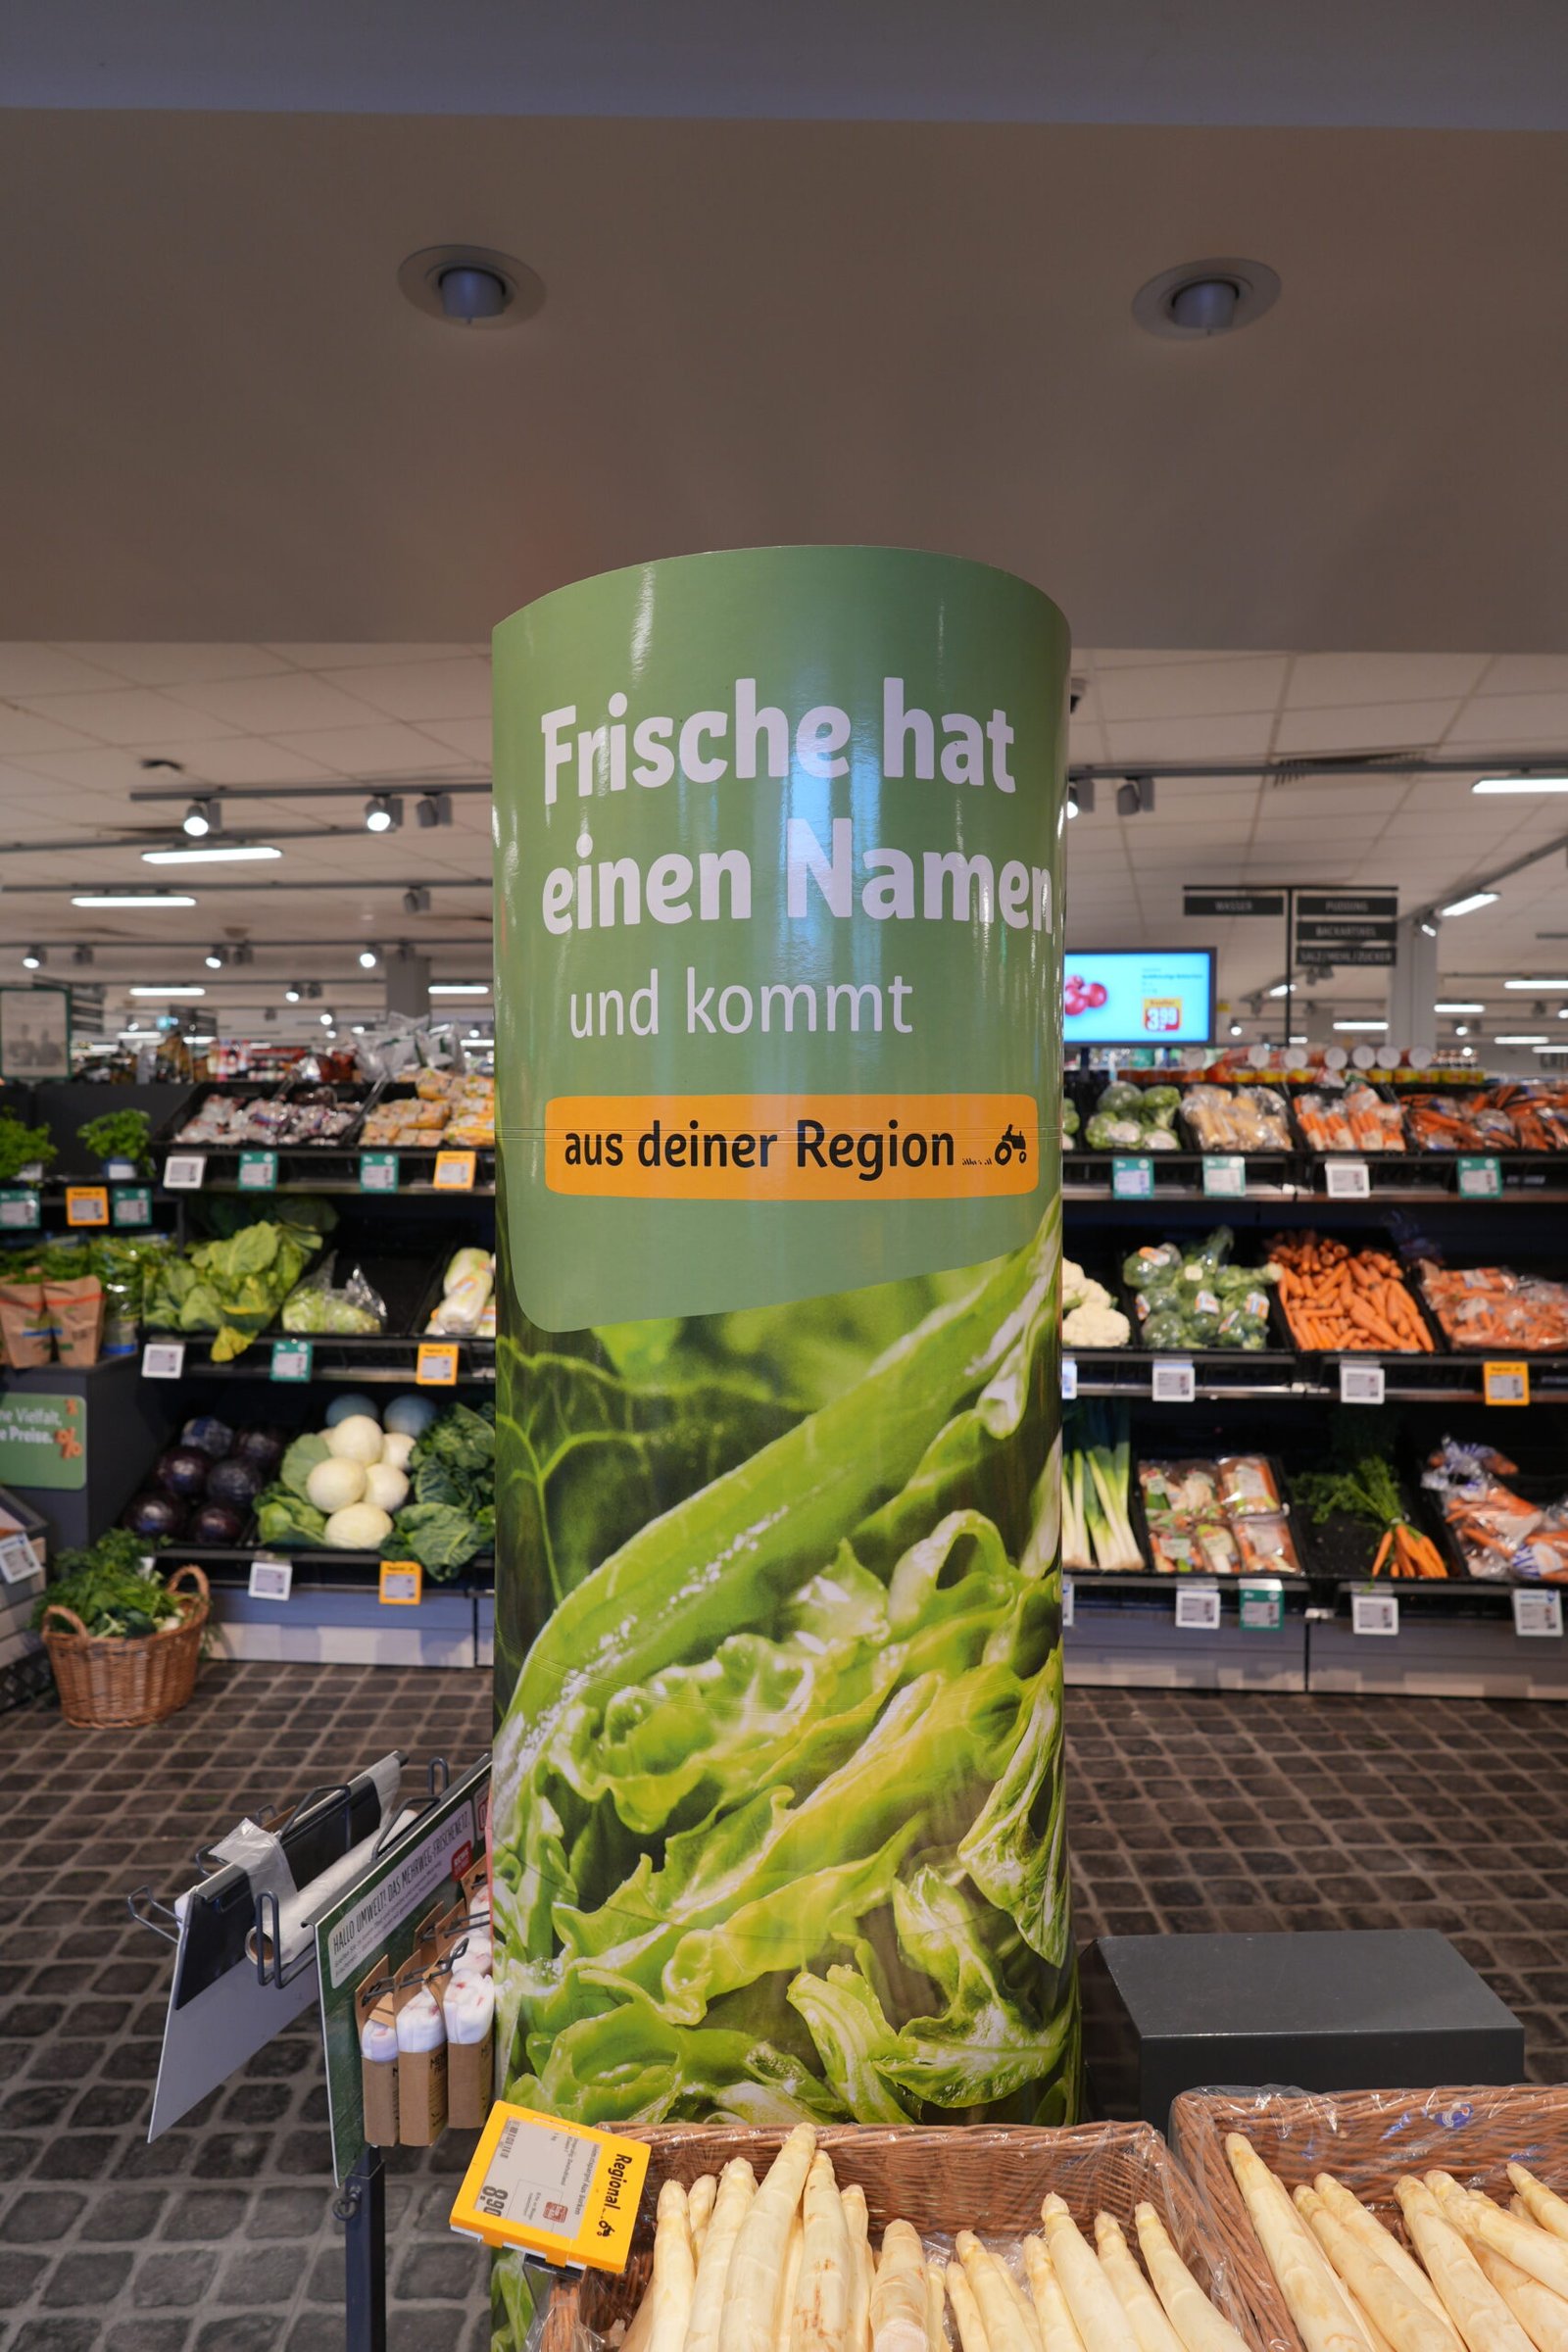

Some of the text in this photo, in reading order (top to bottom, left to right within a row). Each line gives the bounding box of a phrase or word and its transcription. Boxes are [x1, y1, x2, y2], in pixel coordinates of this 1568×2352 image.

[541, 677, 1016, 806] Frische hat
[541, 817, 1053, 936] einen Namen
[1214, 900, 1253, 912] WASSER
[1325, 900, 1369, 912] PUDDING
[569, 967, 913, 1039] und kommt
[564, 1119, 956, 1182] aus deiner Region
[332, 1924, 356, 1957] HALLO
[356, 1892, 388, 1935] UMWELT!
[387, 1878, 403, 1902] DAS
[580, 2182, 589, 2194] Aus
[606, 2153, 632, 2211] Regional
